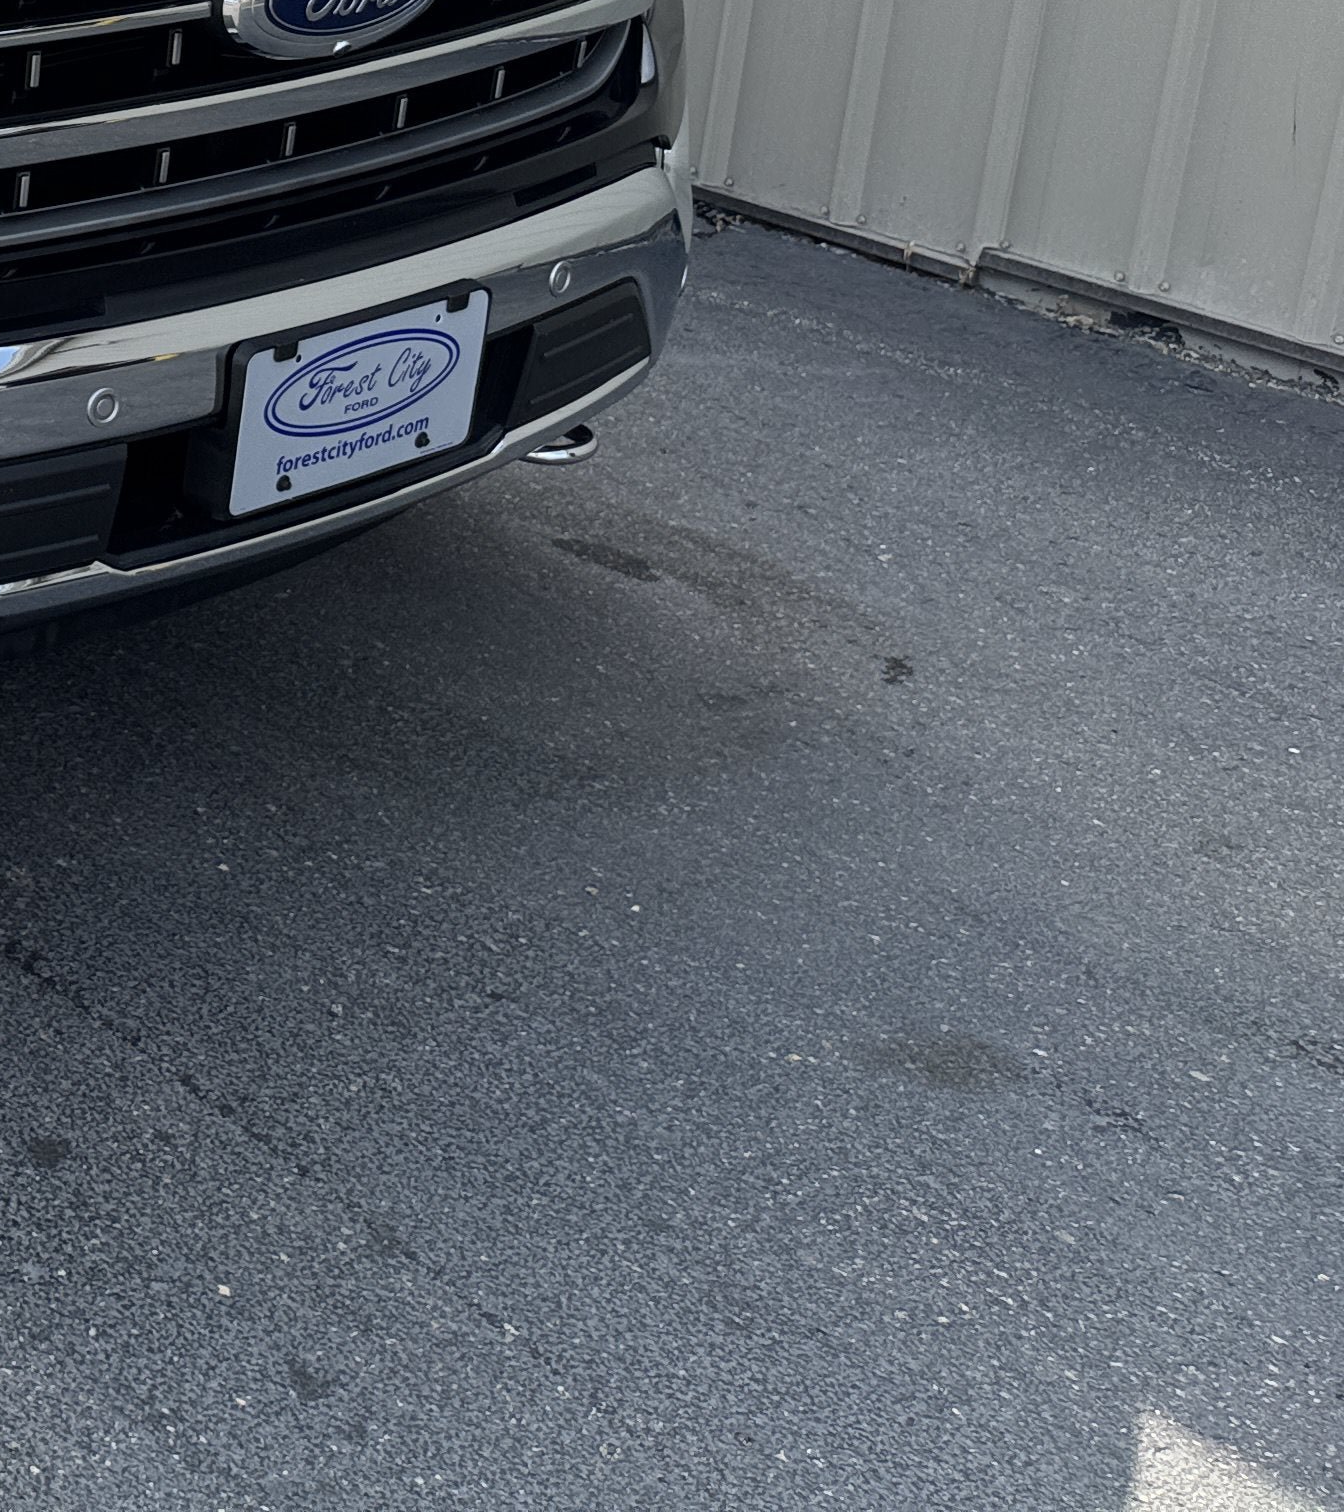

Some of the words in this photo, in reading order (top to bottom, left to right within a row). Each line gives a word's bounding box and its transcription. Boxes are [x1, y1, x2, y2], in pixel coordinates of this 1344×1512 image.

[298, 360, 382, 411] Forest
[387, 347, 433, 394] City
[344, 396, 380, 415] FORD
[275, 416, 430, 475] forestcityford.com
